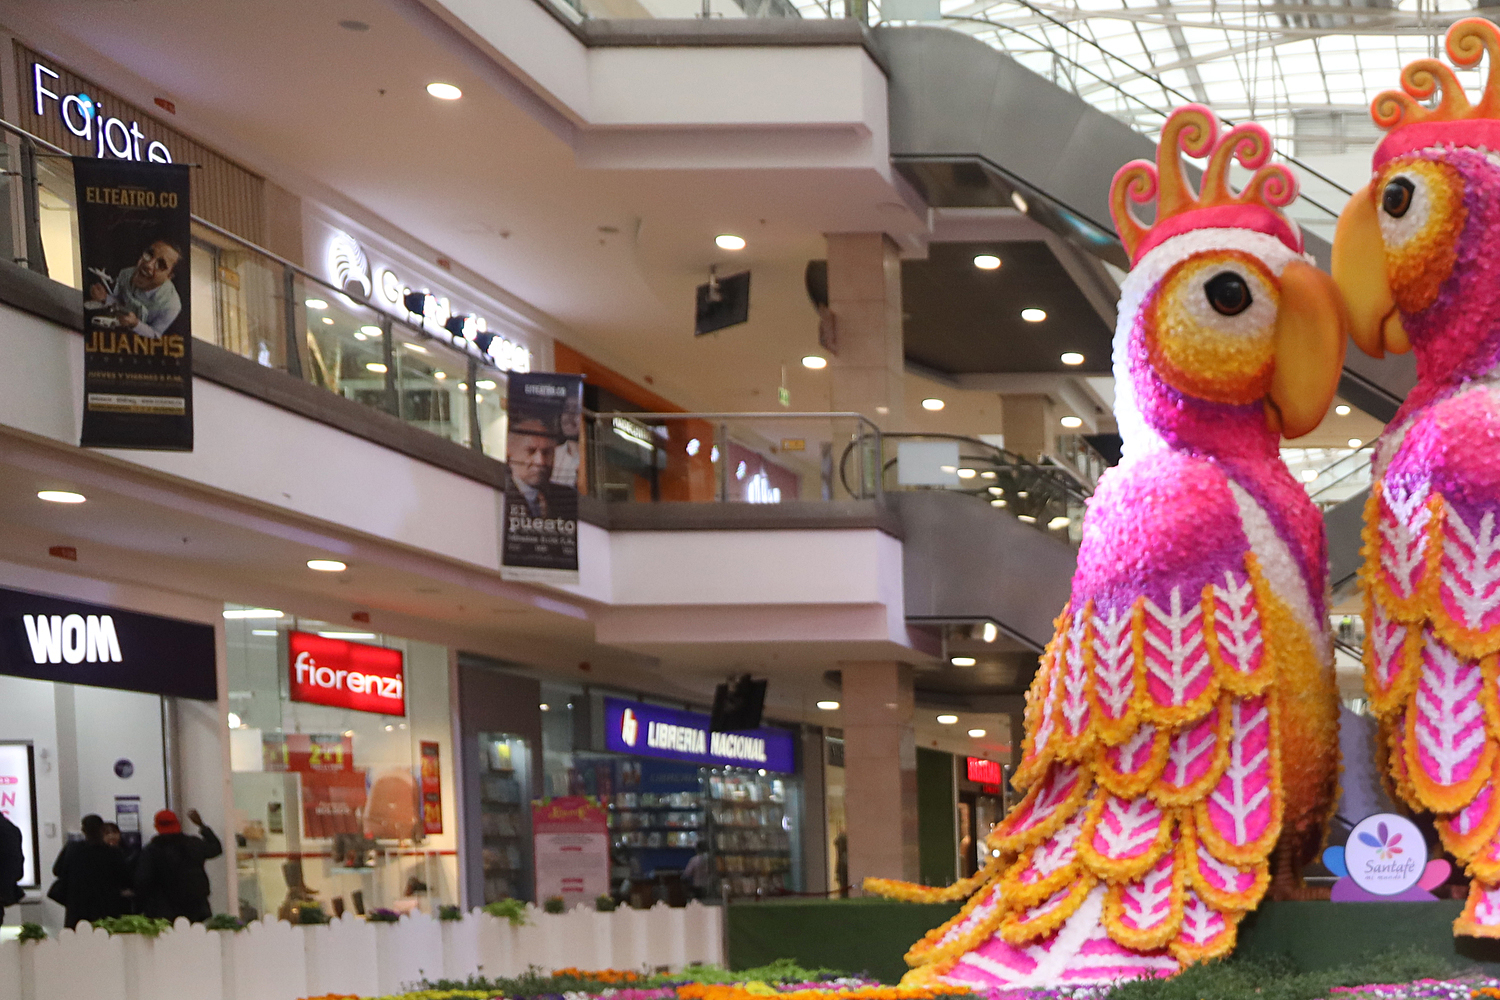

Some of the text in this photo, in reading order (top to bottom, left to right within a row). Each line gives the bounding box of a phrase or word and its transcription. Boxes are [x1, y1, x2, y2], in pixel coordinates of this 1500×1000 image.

[86, 187, 178, 208] ELTEATRO.CO
[508, 516, 576, 535] puesto
[23, 613, 122, 664] WOM
[294, 651, 403, 699] fiorenzi
[647, 720, 768, 763] LIBRERIA NACIONAL
[1364, 857, 1415, 879] Santafé
